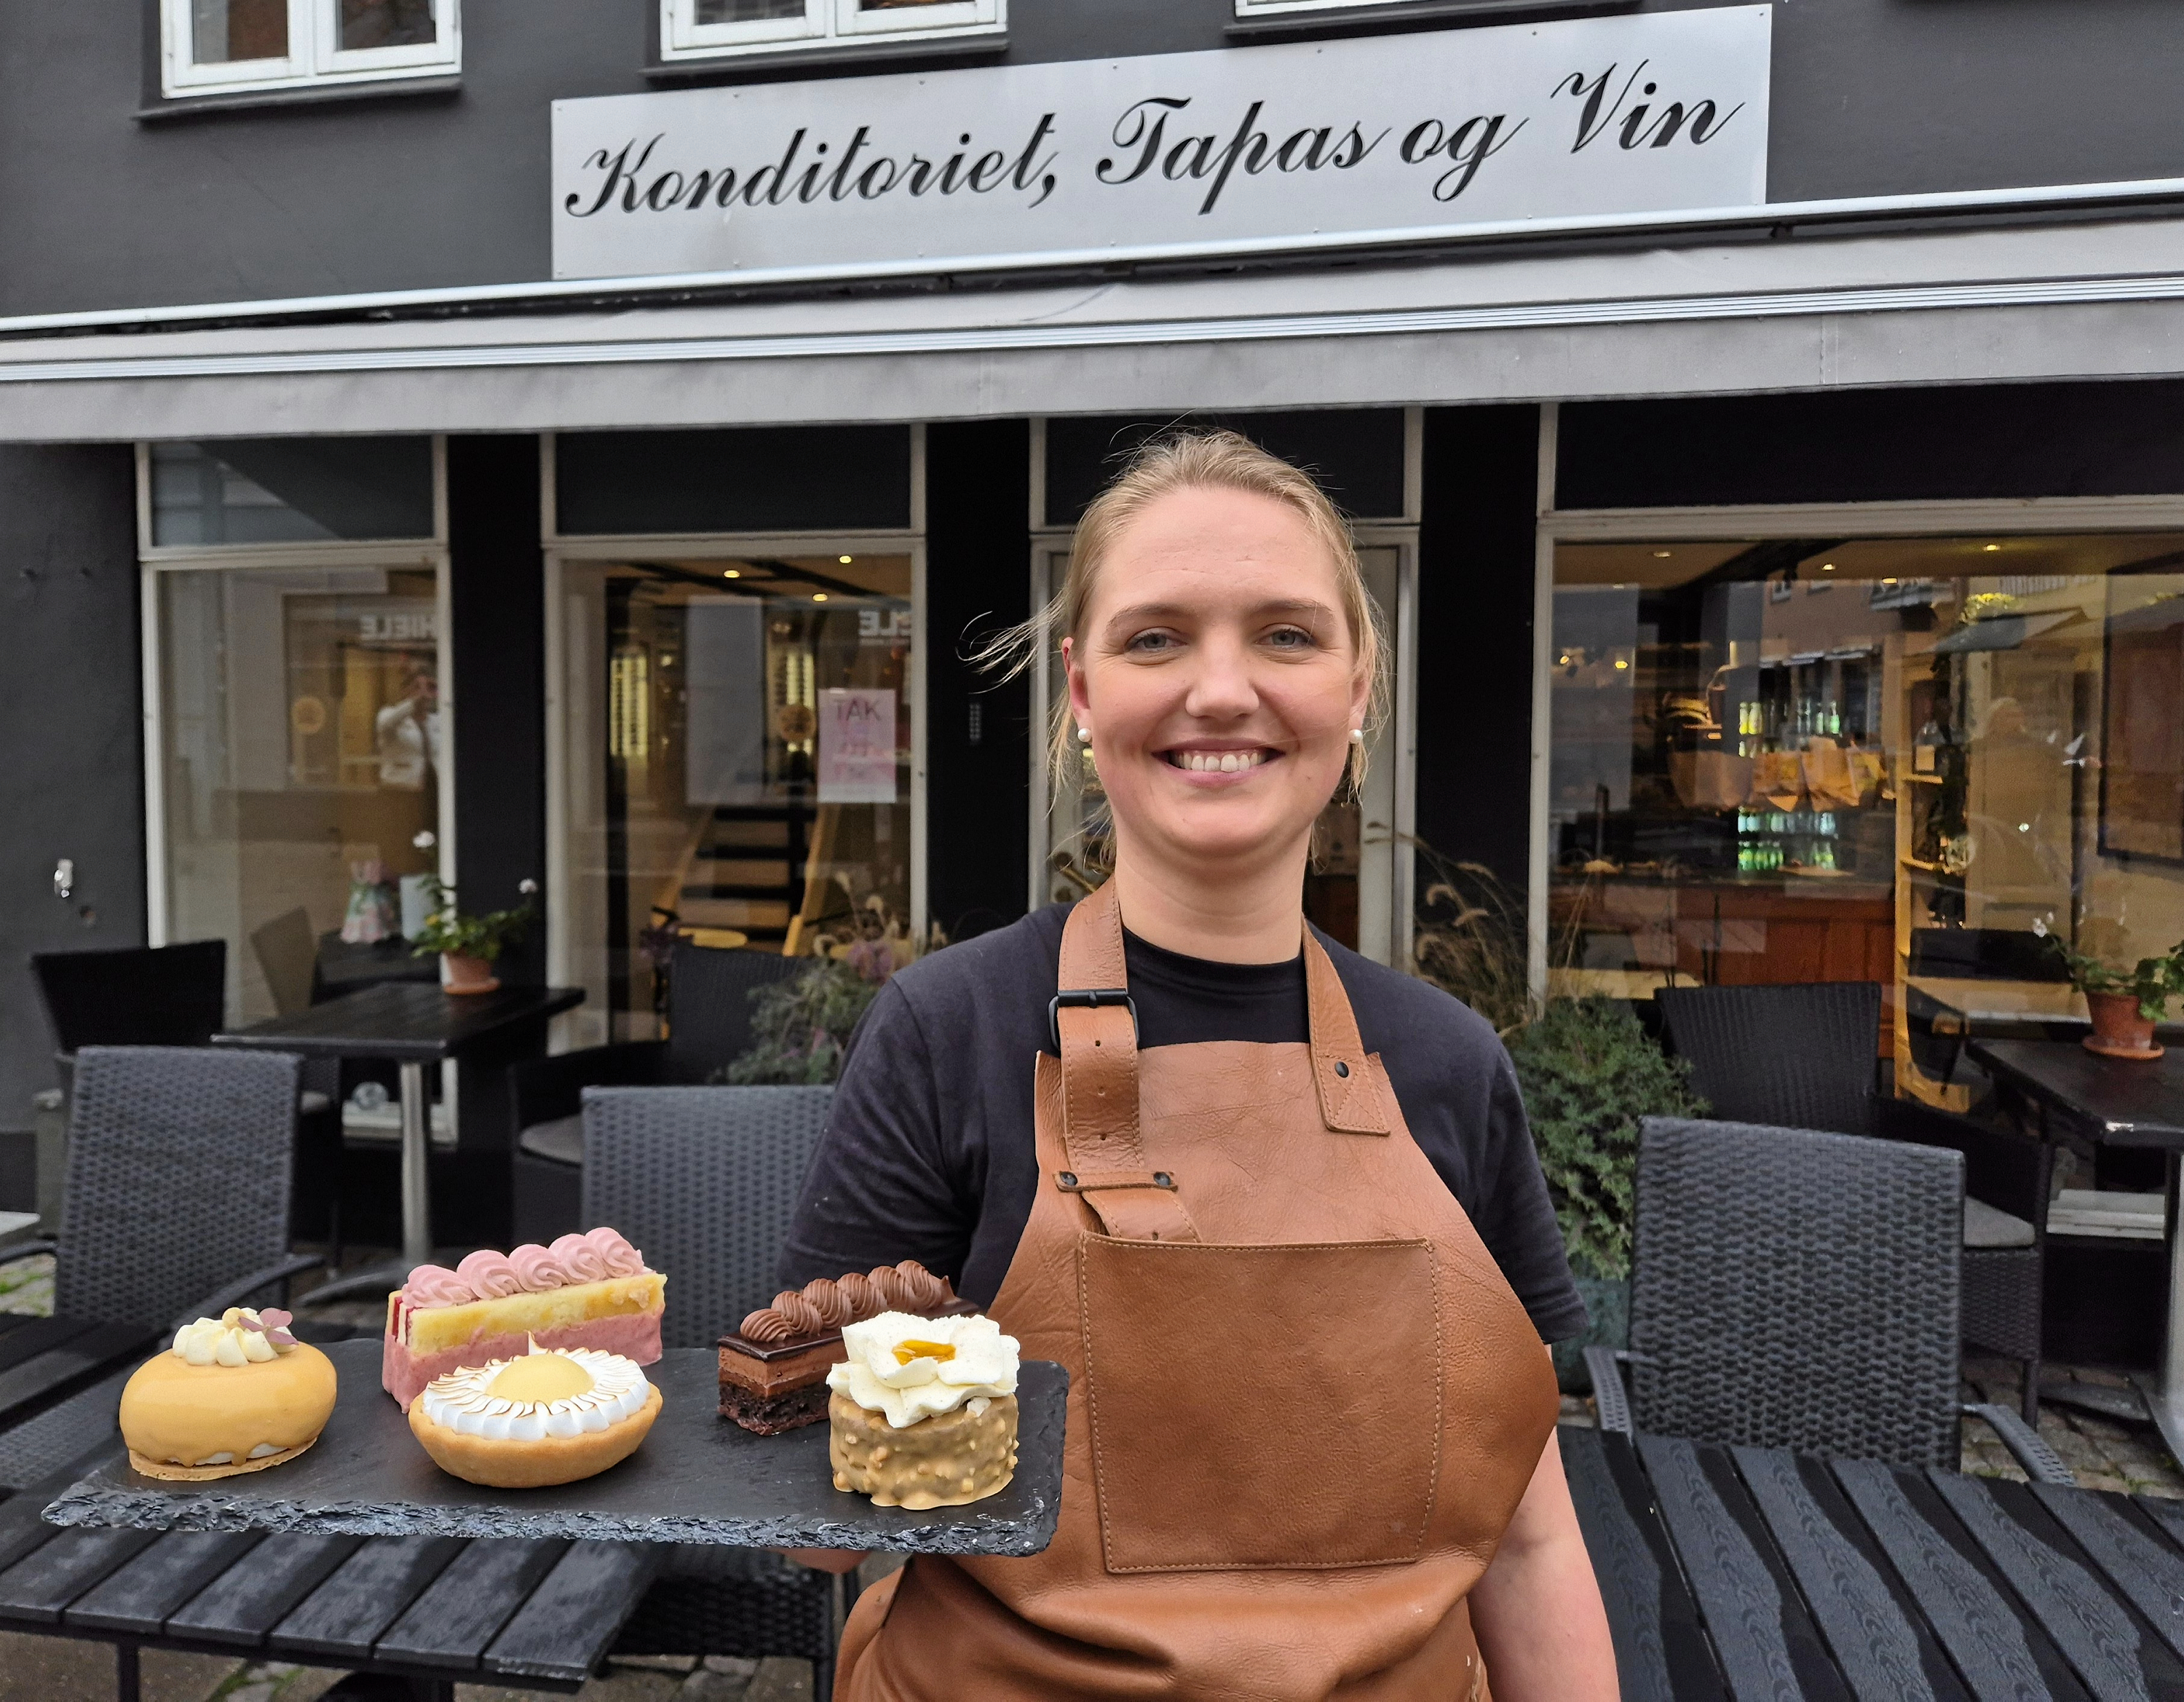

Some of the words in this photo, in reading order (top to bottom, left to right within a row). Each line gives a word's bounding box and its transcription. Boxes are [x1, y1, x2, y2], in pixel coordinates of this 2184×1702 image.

[564, 111, 1060, 218] Konditoriet,
[1094, 96, 1393, 216] Tapas
[1398, 113, 1530, 203] og
[1549, 58, 1746, 154] Vin
[834, 697, 882, 721] TAK
